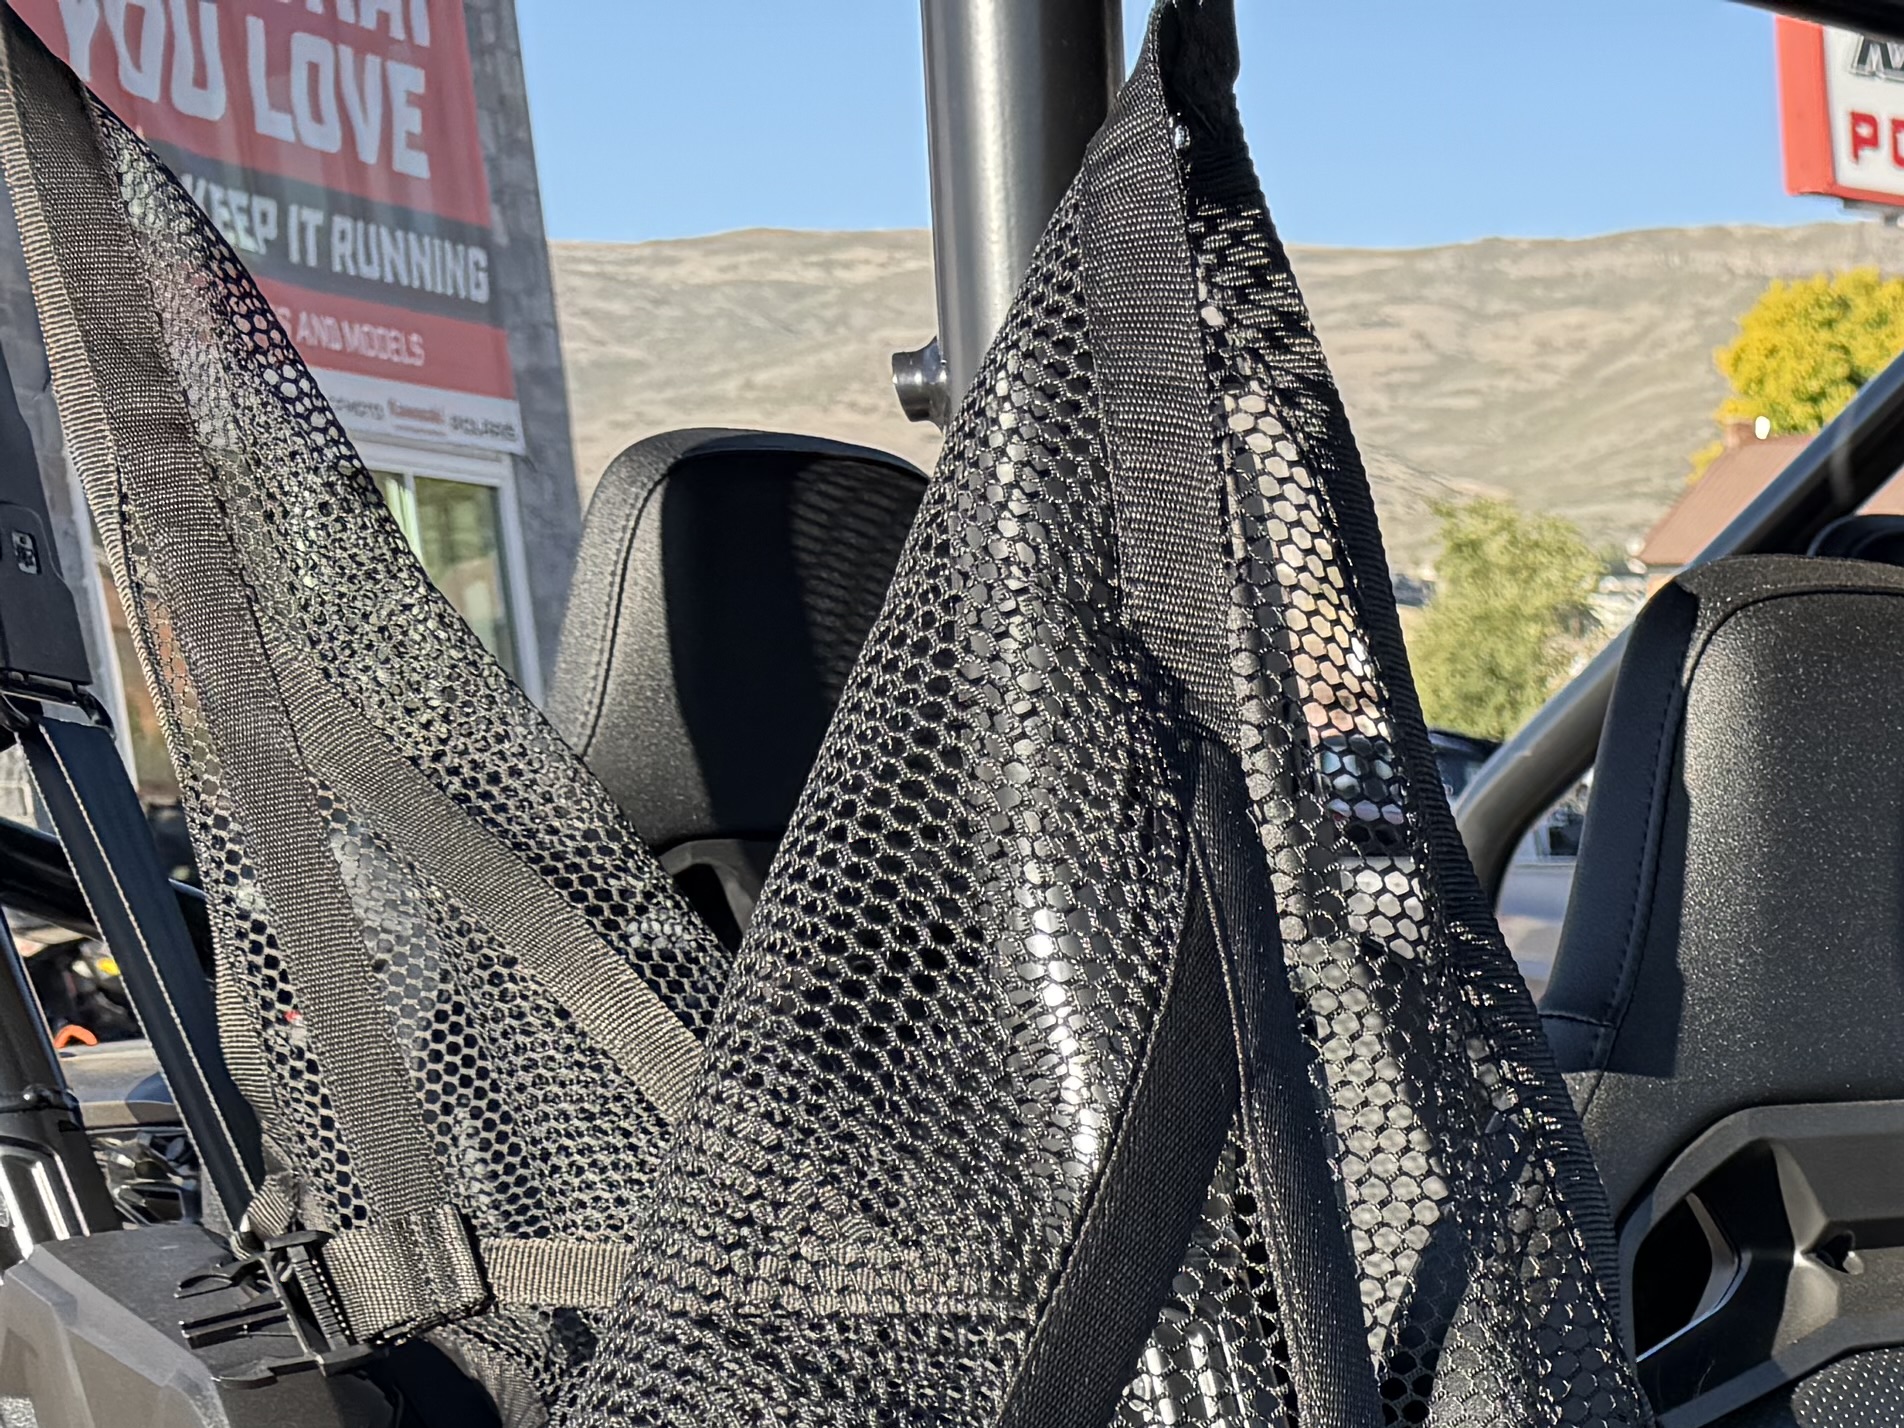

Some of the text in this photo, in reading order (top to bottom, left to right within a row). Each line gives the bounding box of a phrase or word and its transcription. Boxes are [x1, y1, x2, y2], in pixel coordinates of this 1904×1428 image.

[246, 14, 430, 180] LOVE
[287, 204, 324, 268] IT
[330, 214, 491, 305] RUNNING
